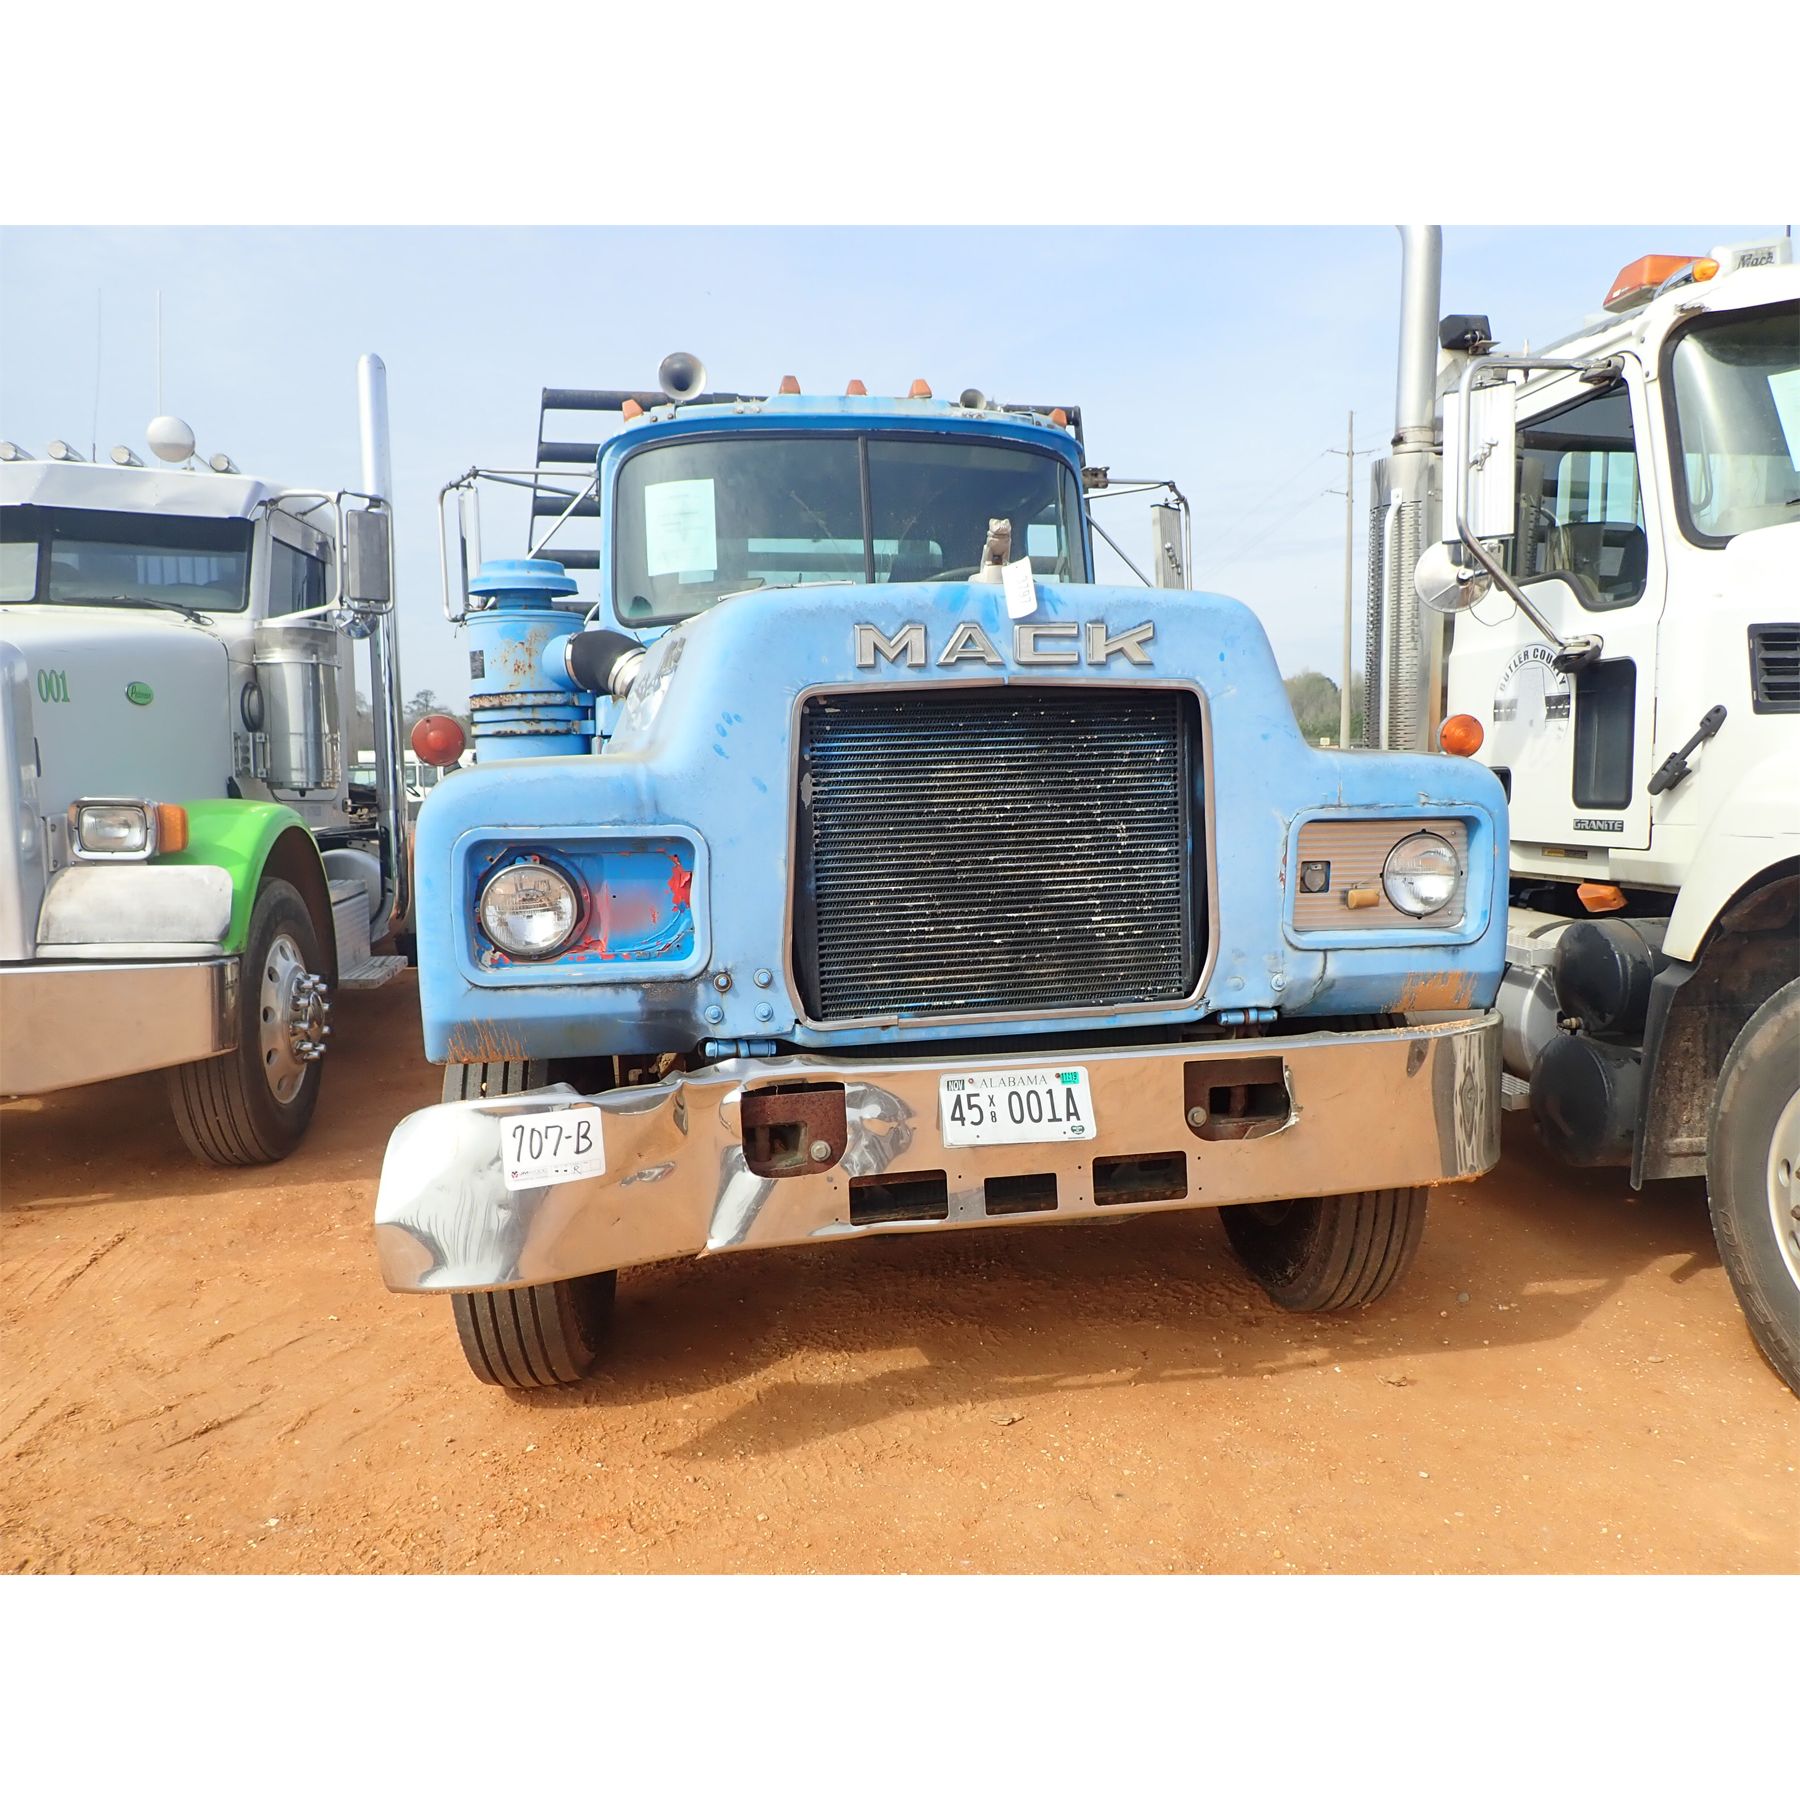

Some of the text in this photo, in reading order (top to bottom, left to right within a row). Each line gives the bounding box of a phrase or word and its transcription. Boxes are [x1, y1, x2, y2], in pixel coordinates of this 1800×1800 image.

[1736, 252, 1775, 270] Mack
[854, 621, 1156, 668] MACK
[37, 668, 71, 704] 001
[1499, 647, 1567, 693] BUTLER COUTY
[946, 1080, 965, 1091] NOV
[979, 1074, 1048, 1089] ALABAMA
[950, 1093, 984, 1127] 45
[1007, 1087, 1081, 1125] 001A
